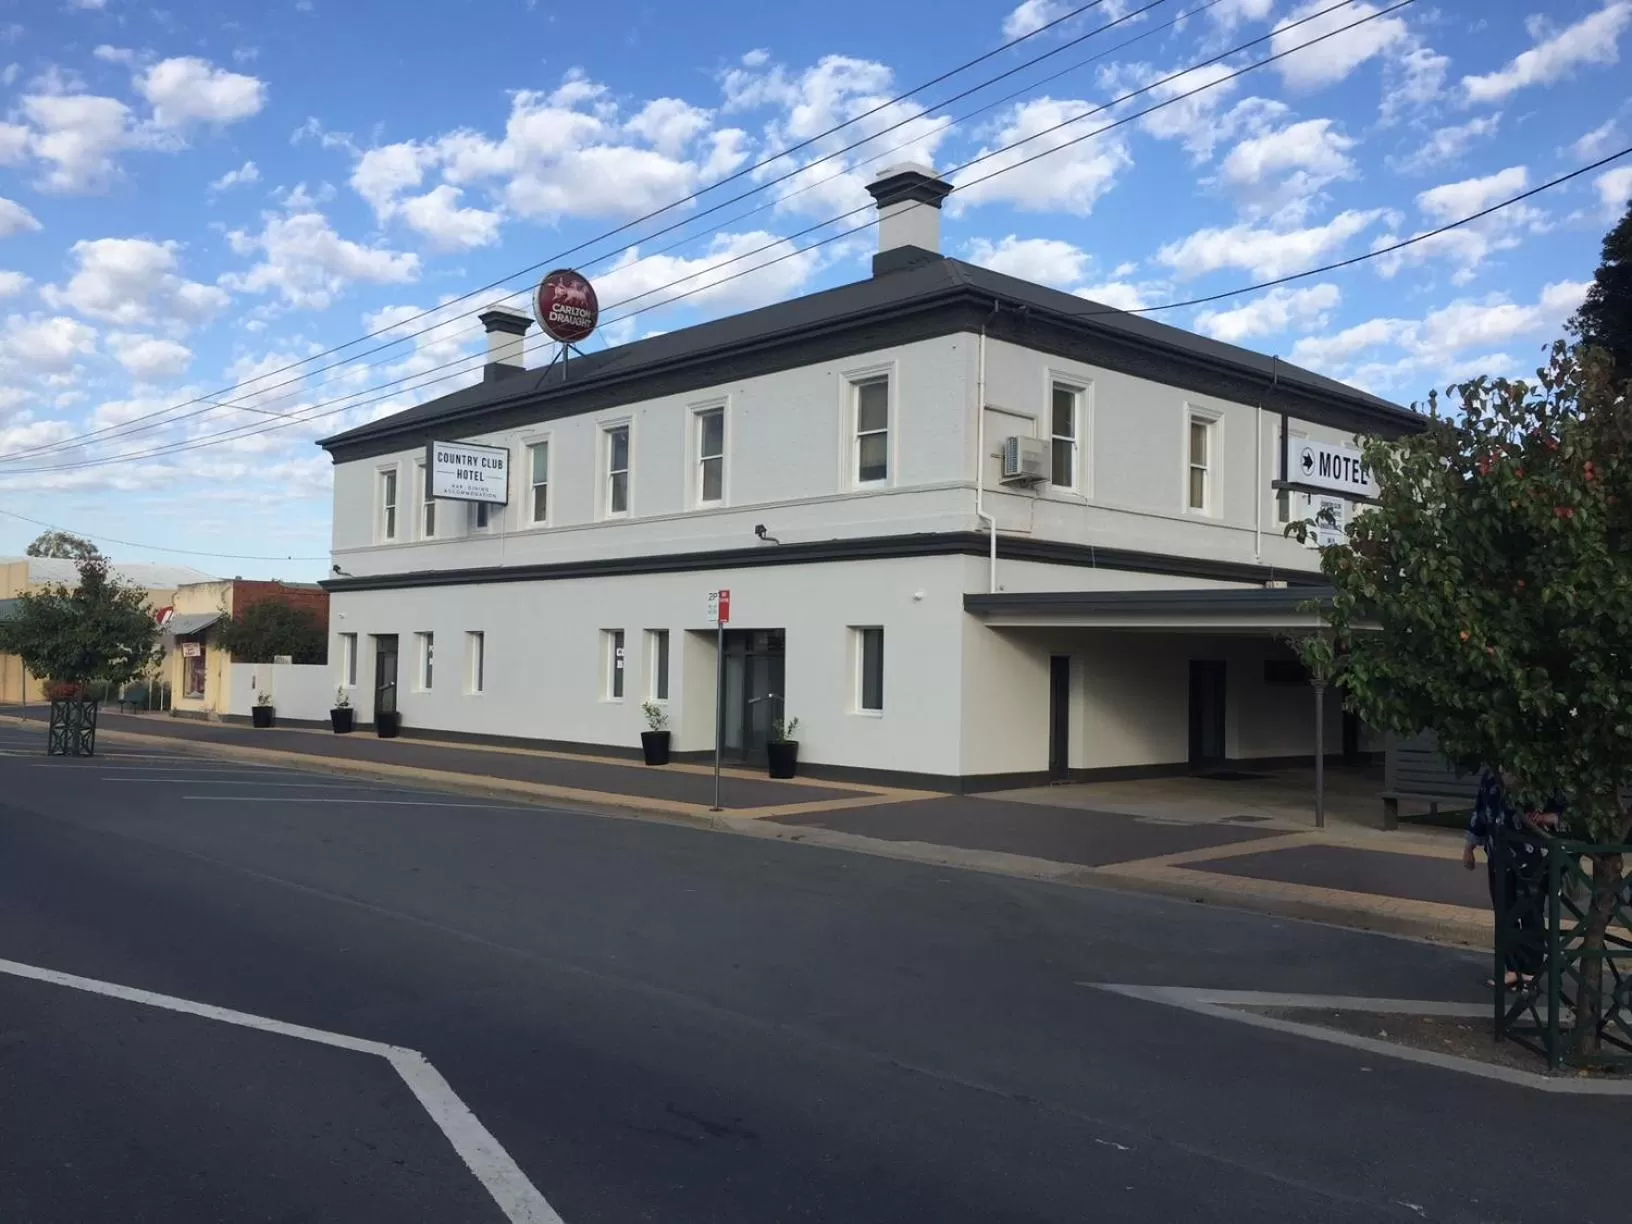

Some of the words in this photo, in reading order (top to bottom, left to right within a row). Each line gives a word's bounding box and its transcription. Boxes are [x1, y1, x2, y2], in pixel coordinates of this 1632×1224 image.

[549, 311, 592, 328] DRAUGHT
[552, 303, 592, 319] CARLTON
[437, 452, 478, 466] COUNTRY
[481, 457, 504, 470] CLUB
[1319, 451, 1368, 485] MOTEL
[456, 468, 484, 482] HOTEL
